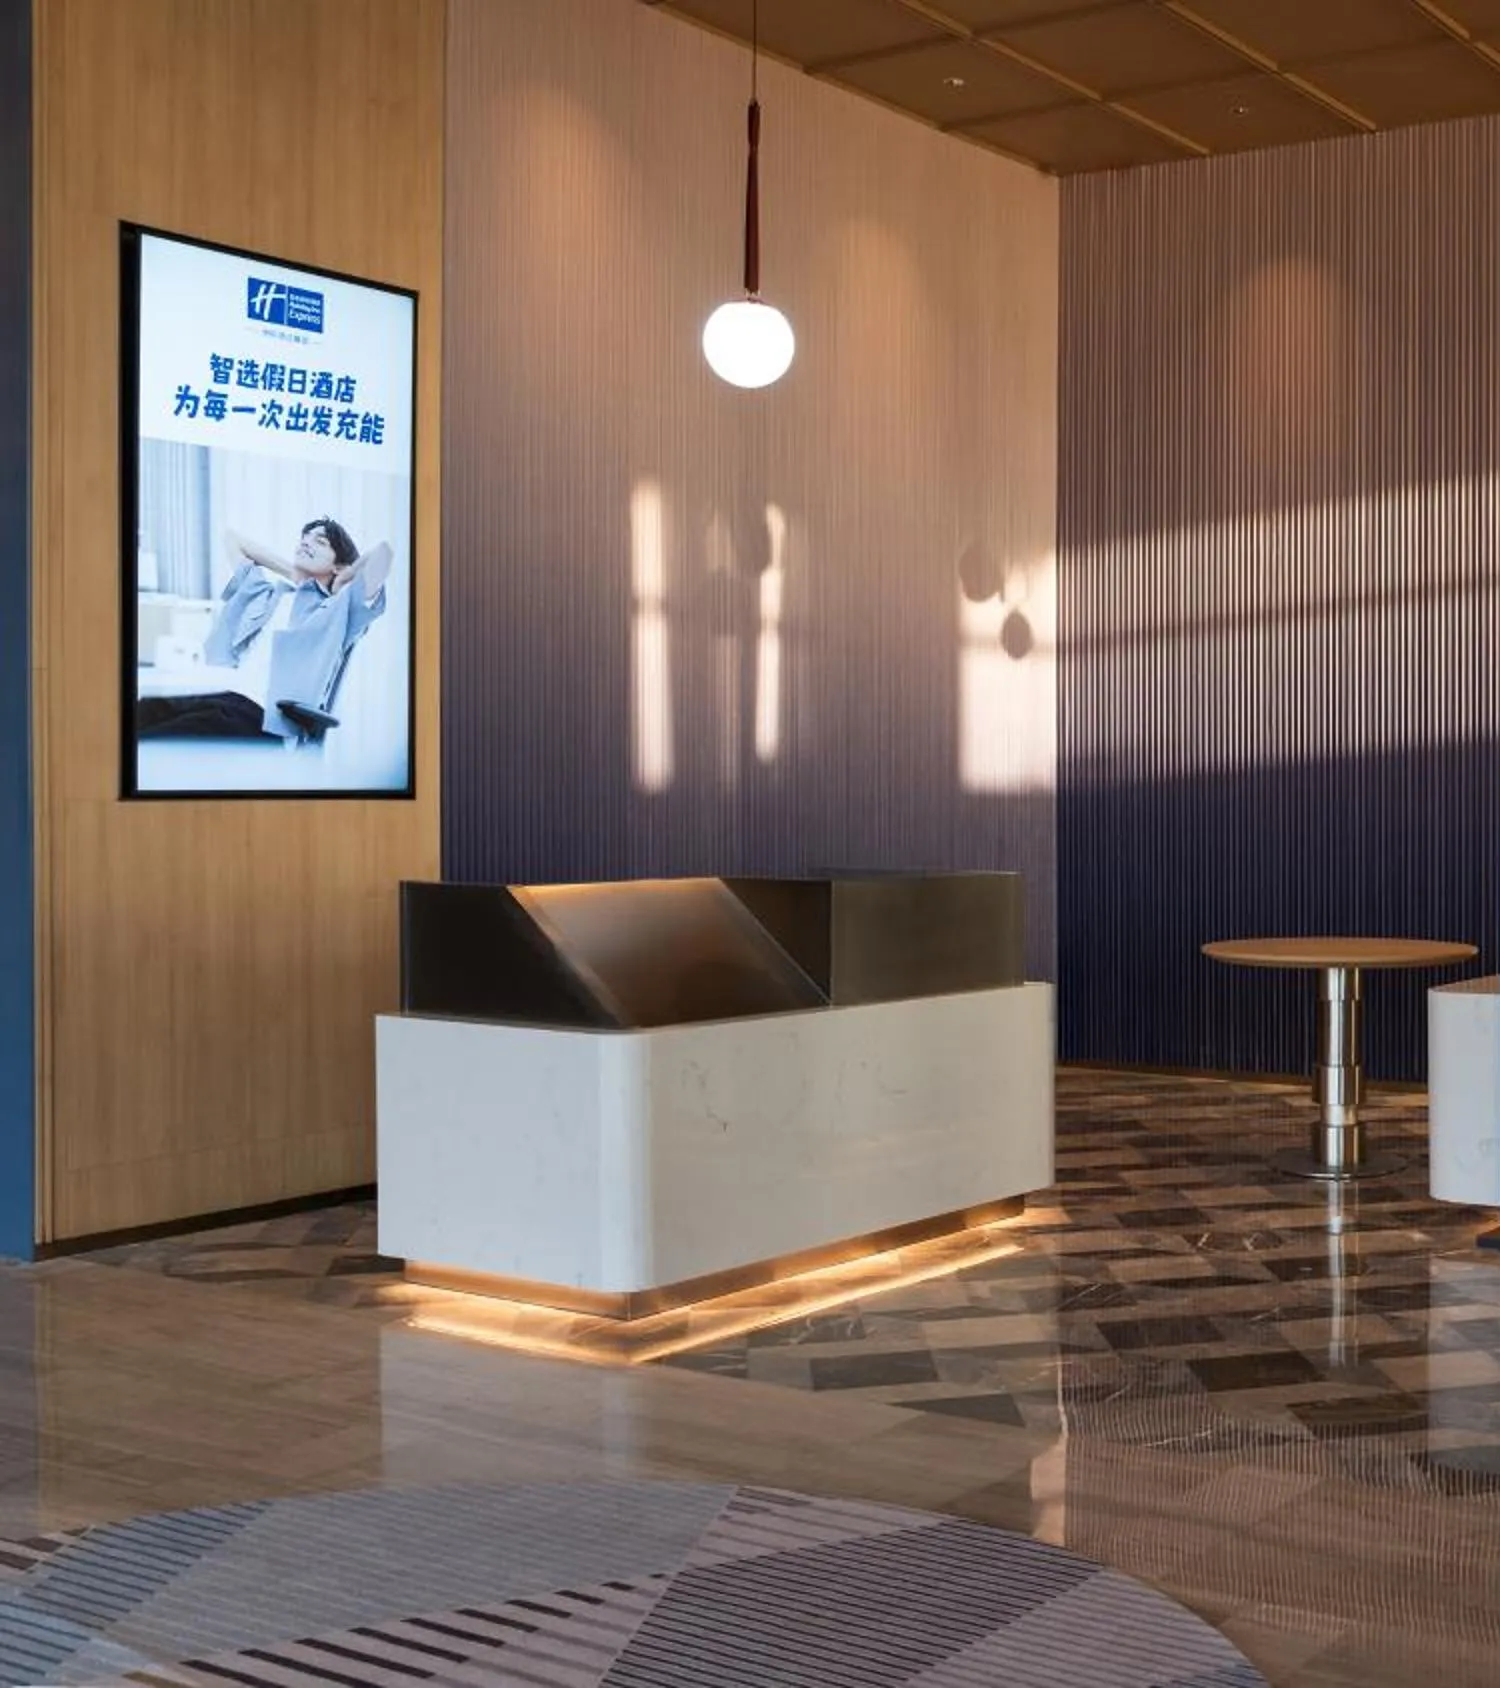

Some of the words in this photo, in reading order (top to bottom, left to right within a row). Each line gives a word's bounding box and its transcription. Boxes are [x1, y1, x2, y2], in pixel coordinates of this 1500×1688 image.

[209, 352, 357, 404] 智选假日酒店
[173, 383, 385, 445] 为每一次出发充能
